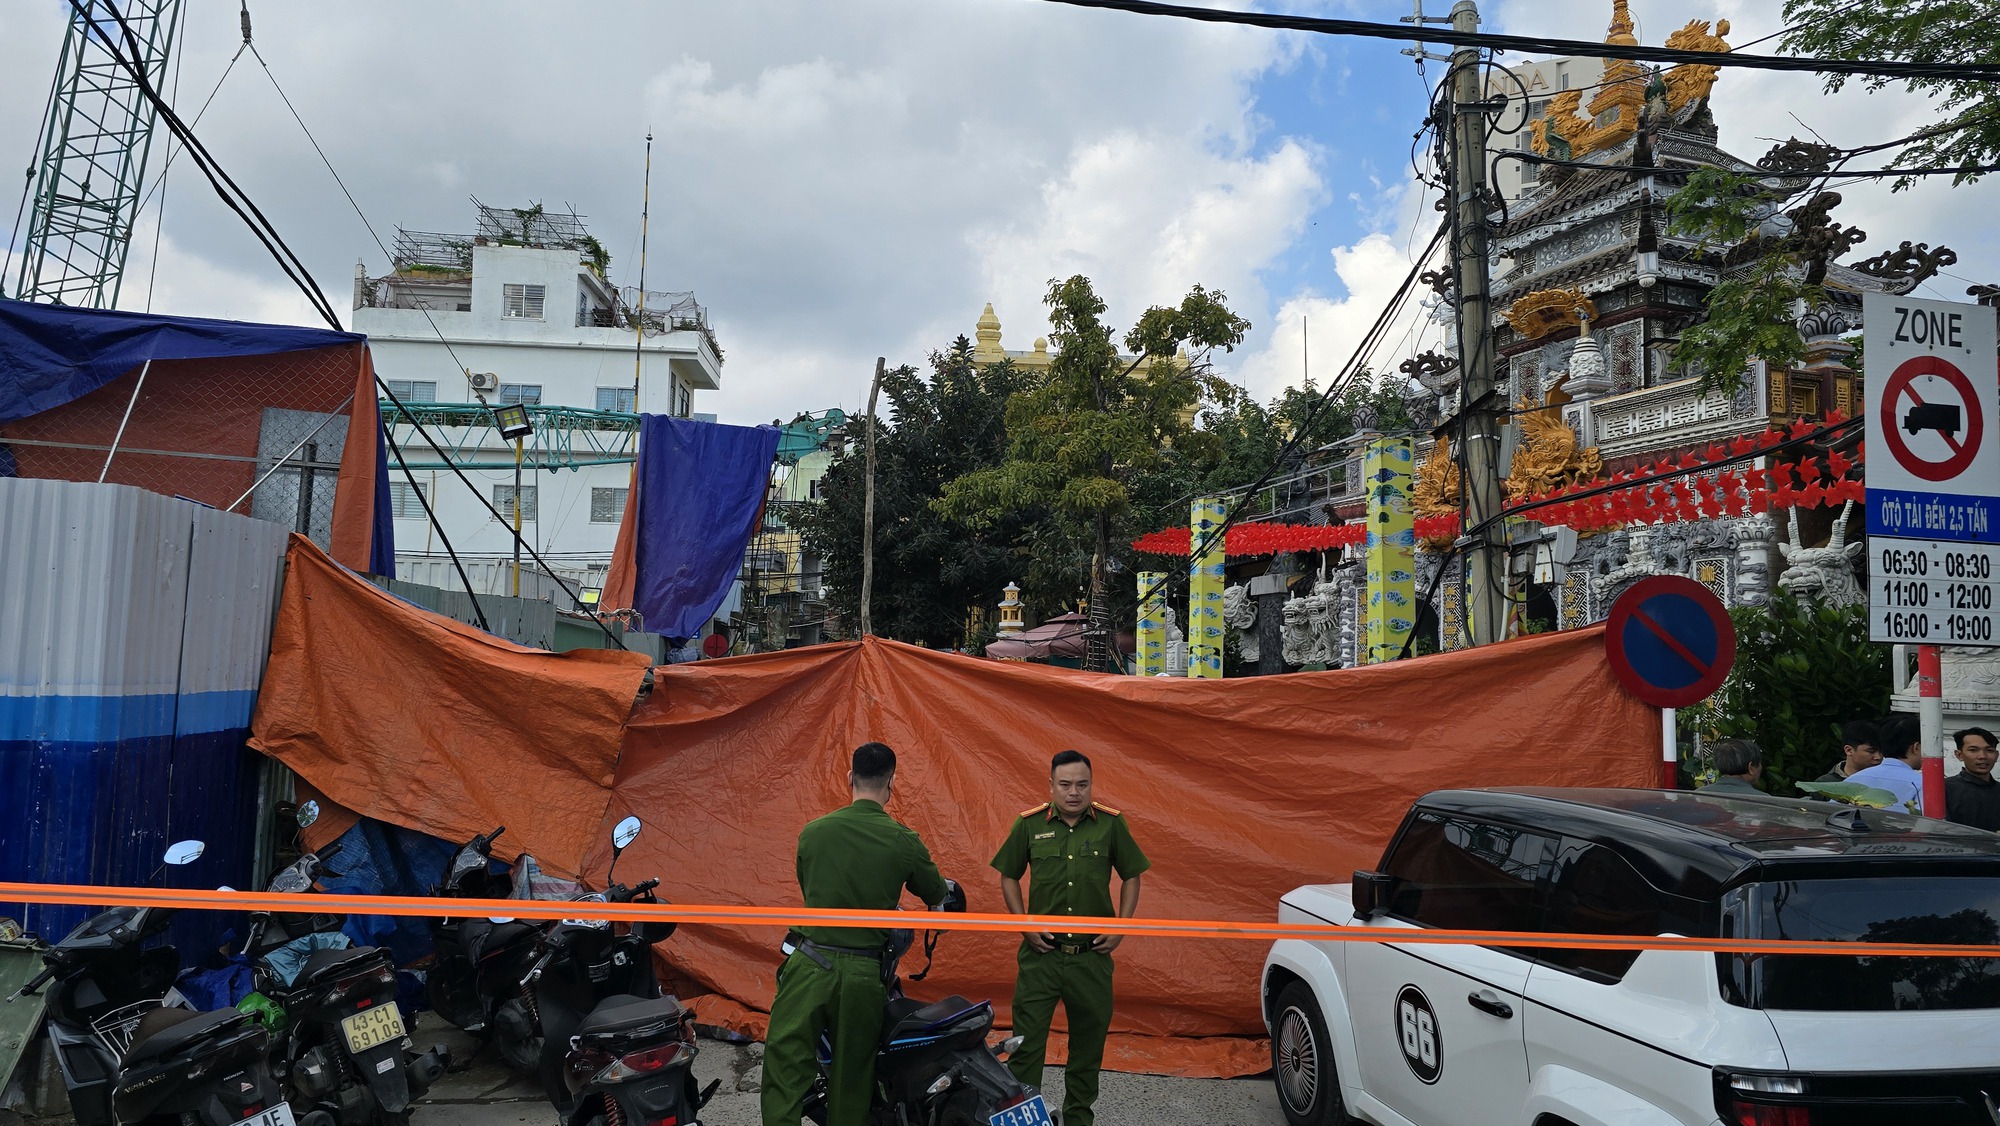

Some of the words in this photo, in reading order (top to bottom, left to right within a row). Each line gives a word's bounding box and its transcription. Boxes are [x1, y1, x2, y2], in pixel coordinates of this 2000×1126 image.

[1480, 69, 1549, 98] NDA
[1895, 307, 1963, 348] ZONE
[1905, 496, 1922, 529] TẢI
[1925, 497, 1946, 530] ĐẾN
[1949, 505, 1964, 536] 2,5
[1966, 500, 1988, 533] TẤN
[1882, 549, 1928, 576] 06:30
[1945, 552, 1990, 579] 08:30
[1884, 580, 1928, 607] 11:00
[1947, 583, 1992, 610] 12:00
[1884, 611, 1928, 638] 16:00
[1947, 614, 1992, 641] 19:00
[352, 1006, 391, 1032] 43-C1
[351, 1020, 401, 1050] 691.09
[1401, 1000, 1437, 1069] 66
[223, 1070, 245, 1081] HONDA
